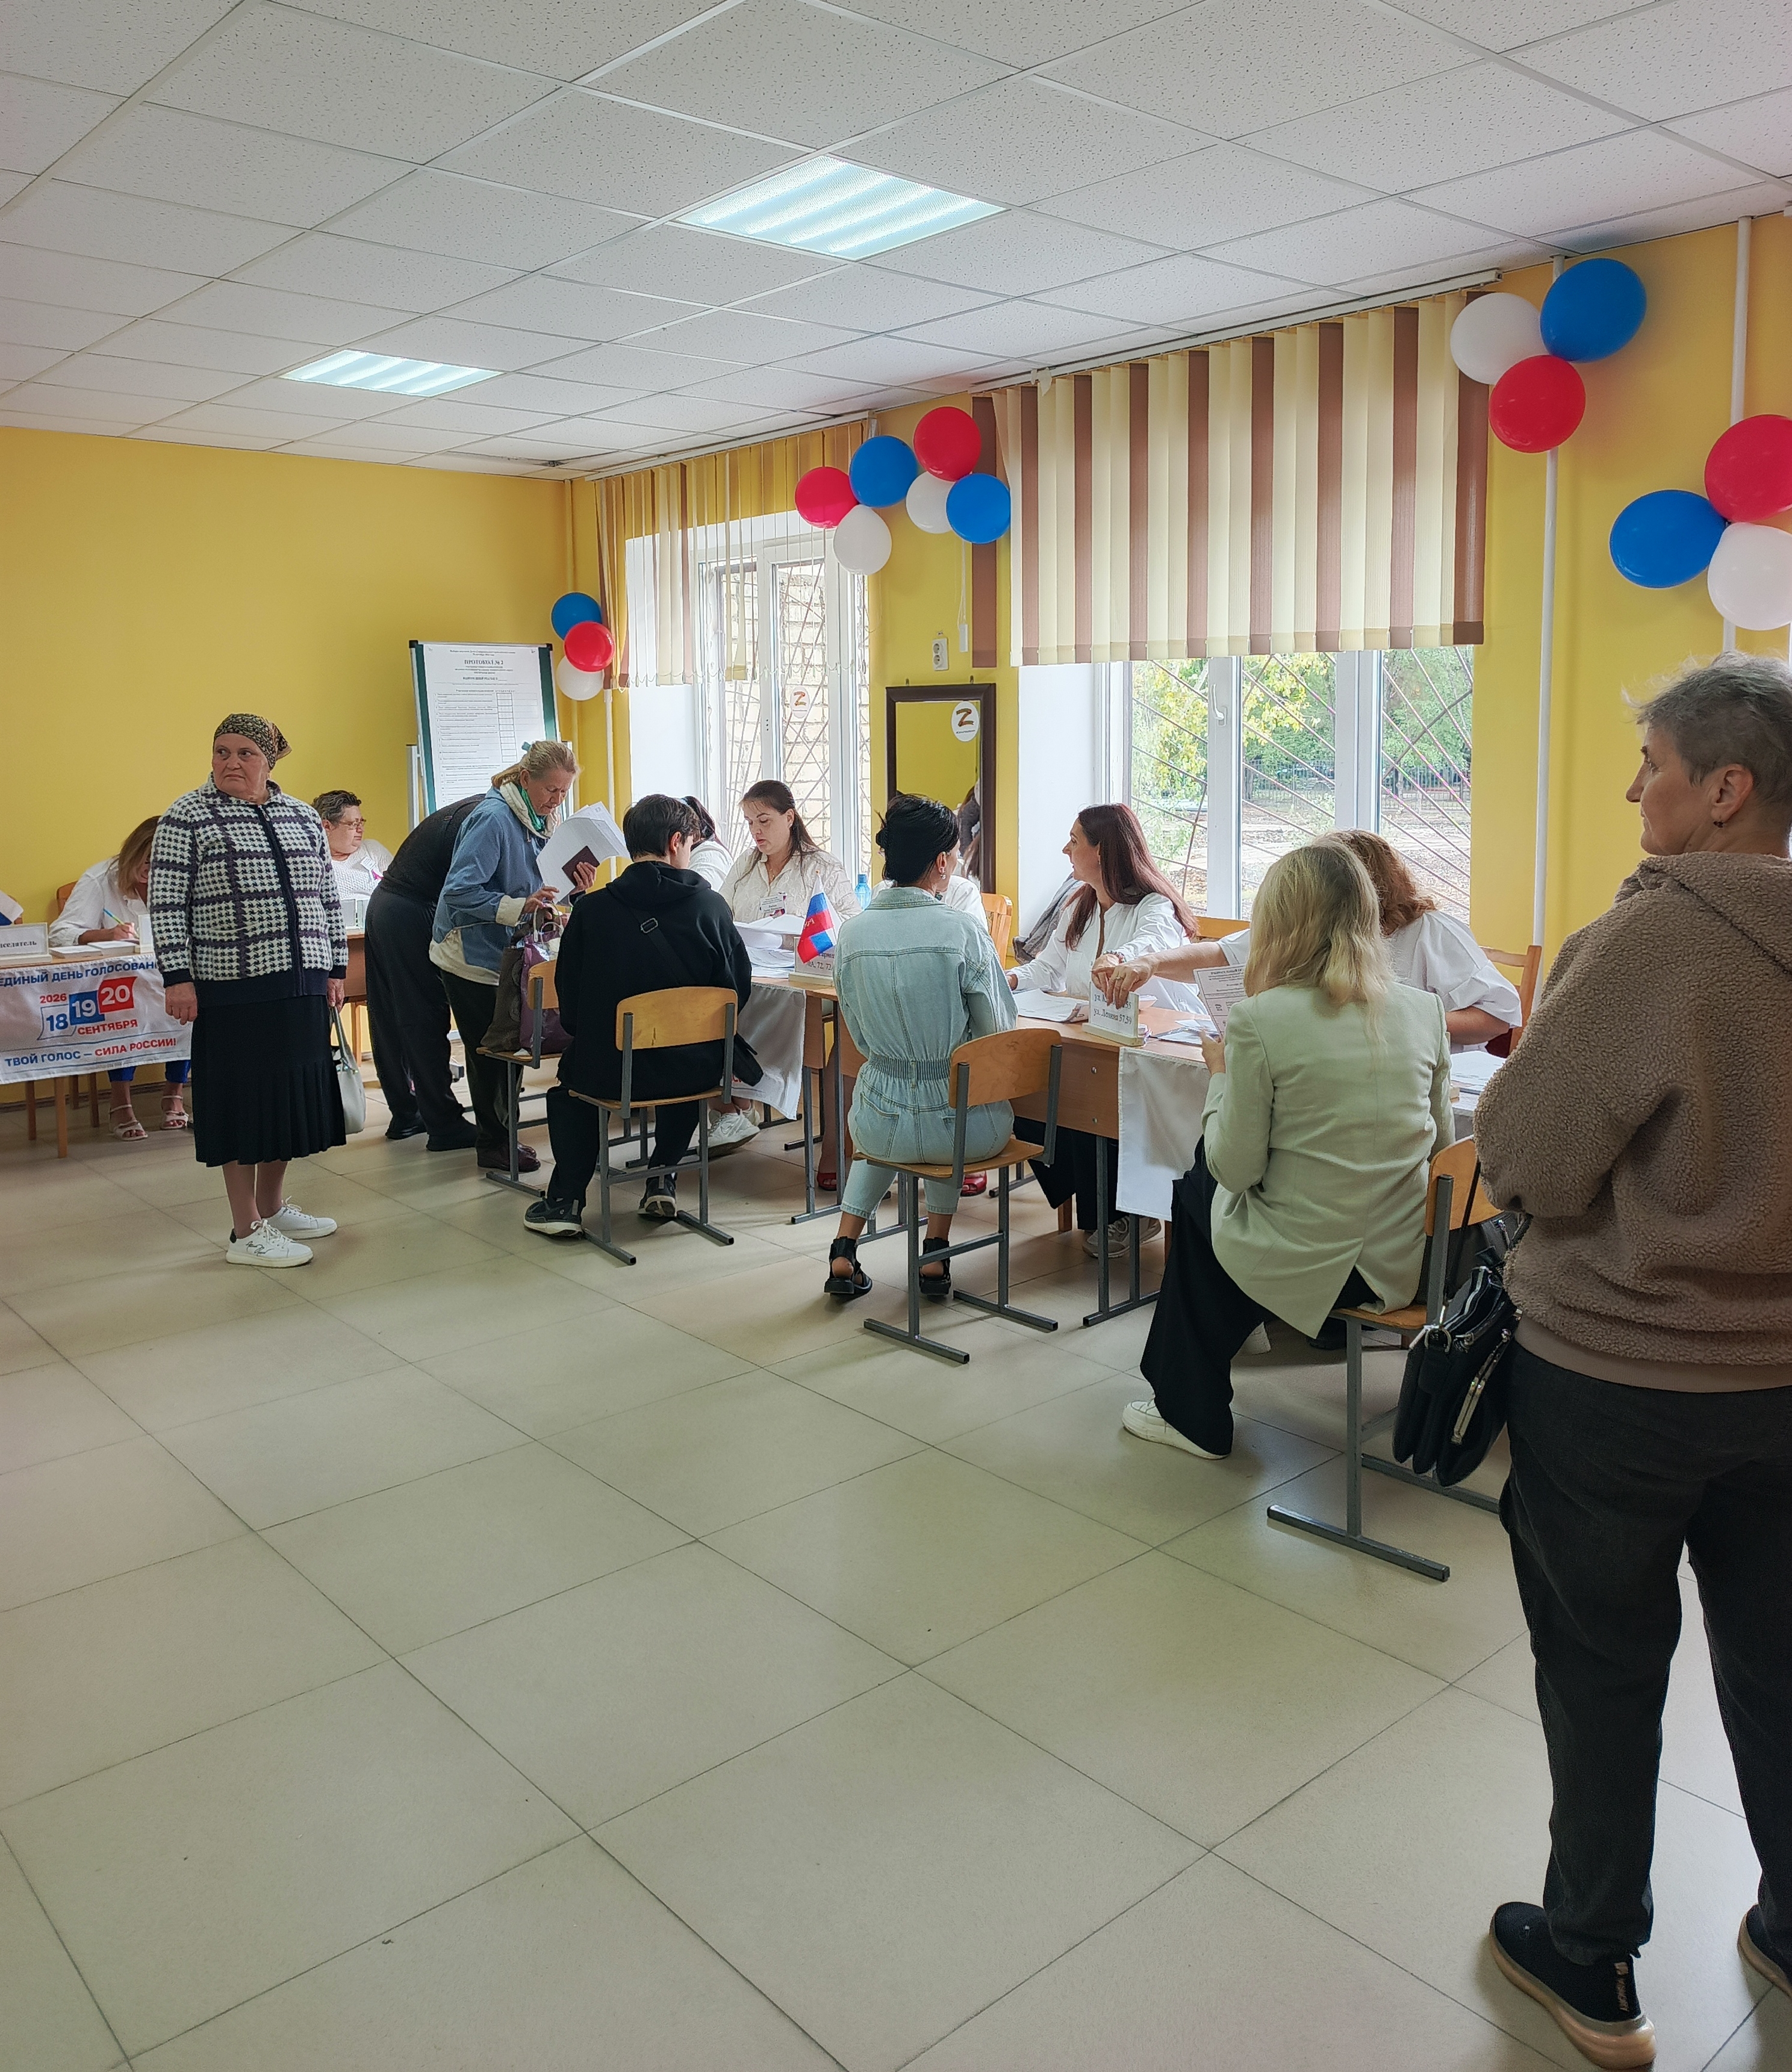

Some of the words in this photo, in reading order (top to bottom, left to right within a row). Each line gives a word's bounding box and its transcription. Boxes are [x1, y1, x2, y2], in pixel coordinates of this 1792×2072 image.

[794, 691, 806, 706] Z
[956, 708, 974, 727] Z
[51, 969, 84, 982] ДЕНЬ
[40, 994, 67, 1004] 2026
[101, 985, 130, 1006] 20
[72, 1000, 96, 1018] 19
[46, 1013, 69, 1031] 18
[77, 1019, 138, 1035] СЕНТЯБРЯ
[5, 1053, 38, 1067] ТВОЙ
[41, 1051, 81, 1062] ГОЛОС
[95, 1044, 127, 1056] СИЛА
[129, 1038, 176, 1051] РОССИИ!
